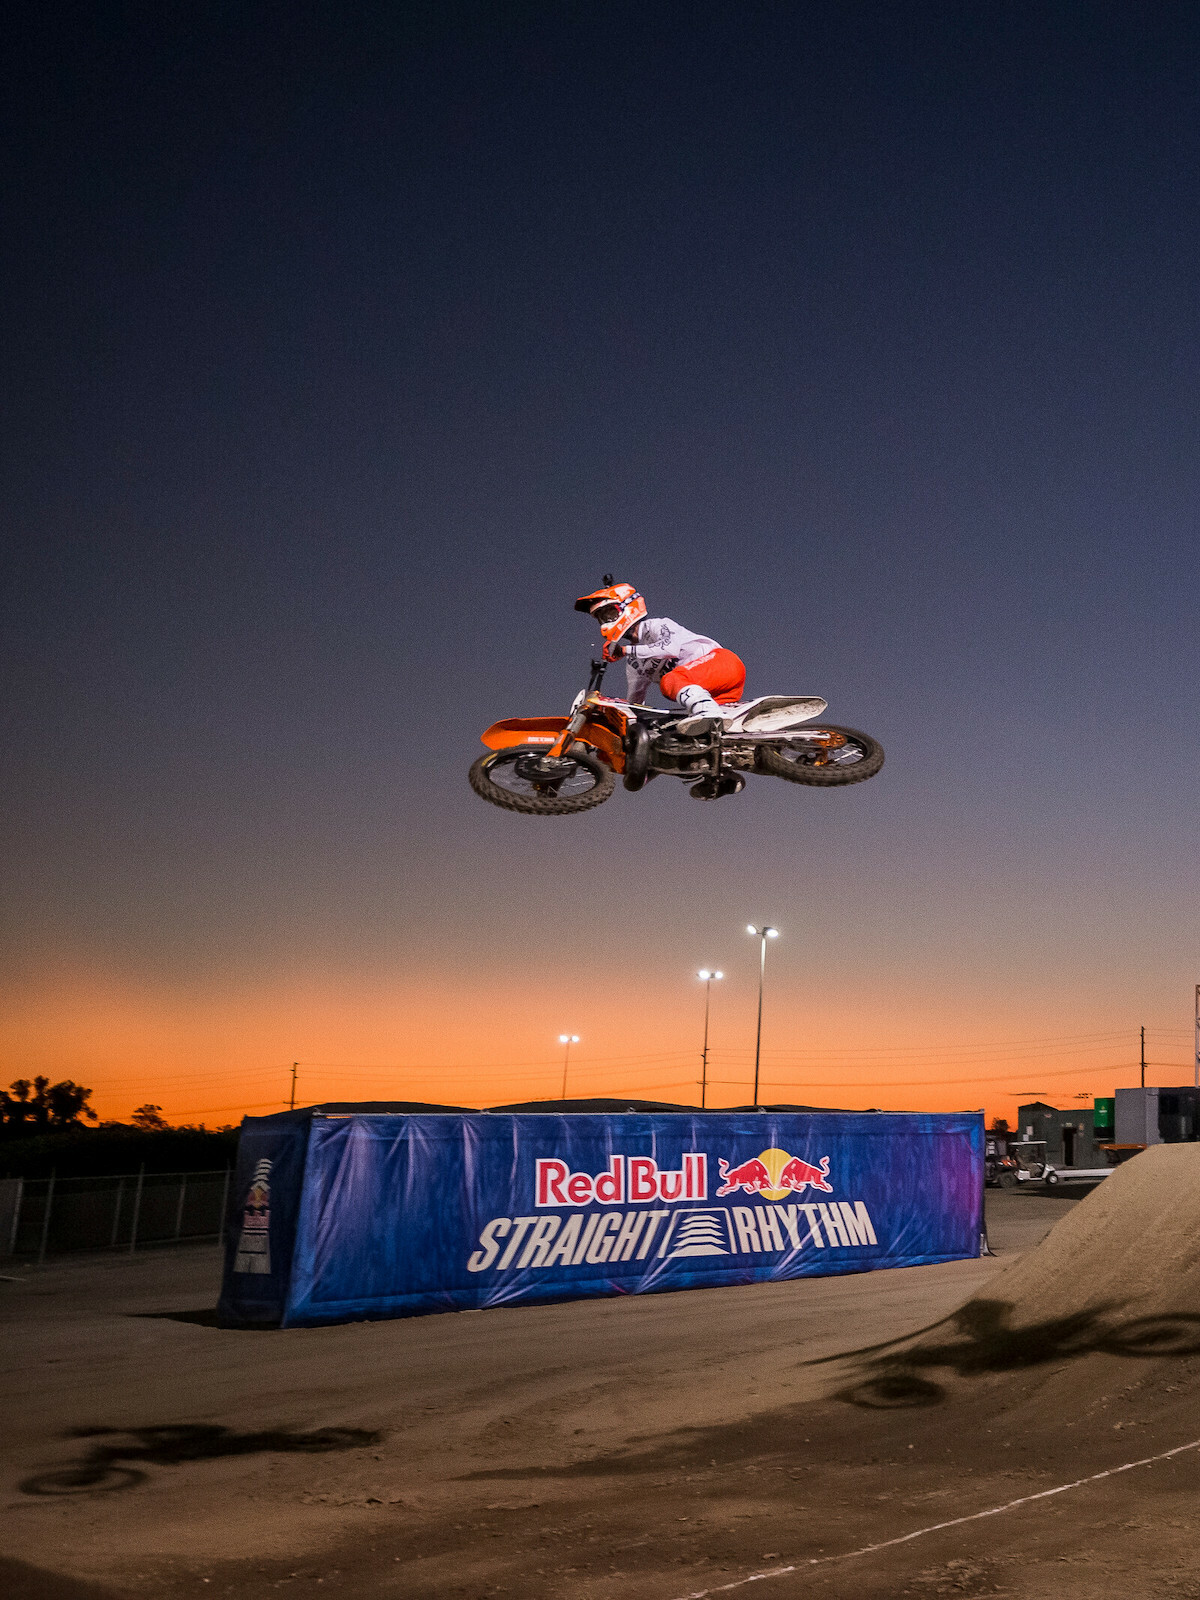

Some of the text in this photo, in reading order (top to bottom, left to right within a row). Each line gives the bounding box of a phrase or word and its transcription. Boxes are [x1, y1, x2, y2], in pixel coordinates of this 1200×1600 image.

[535, 1152, 708, 1207] Red Bull
[467, 1200, 878, 1273] STRAIGHT RHYTHM
